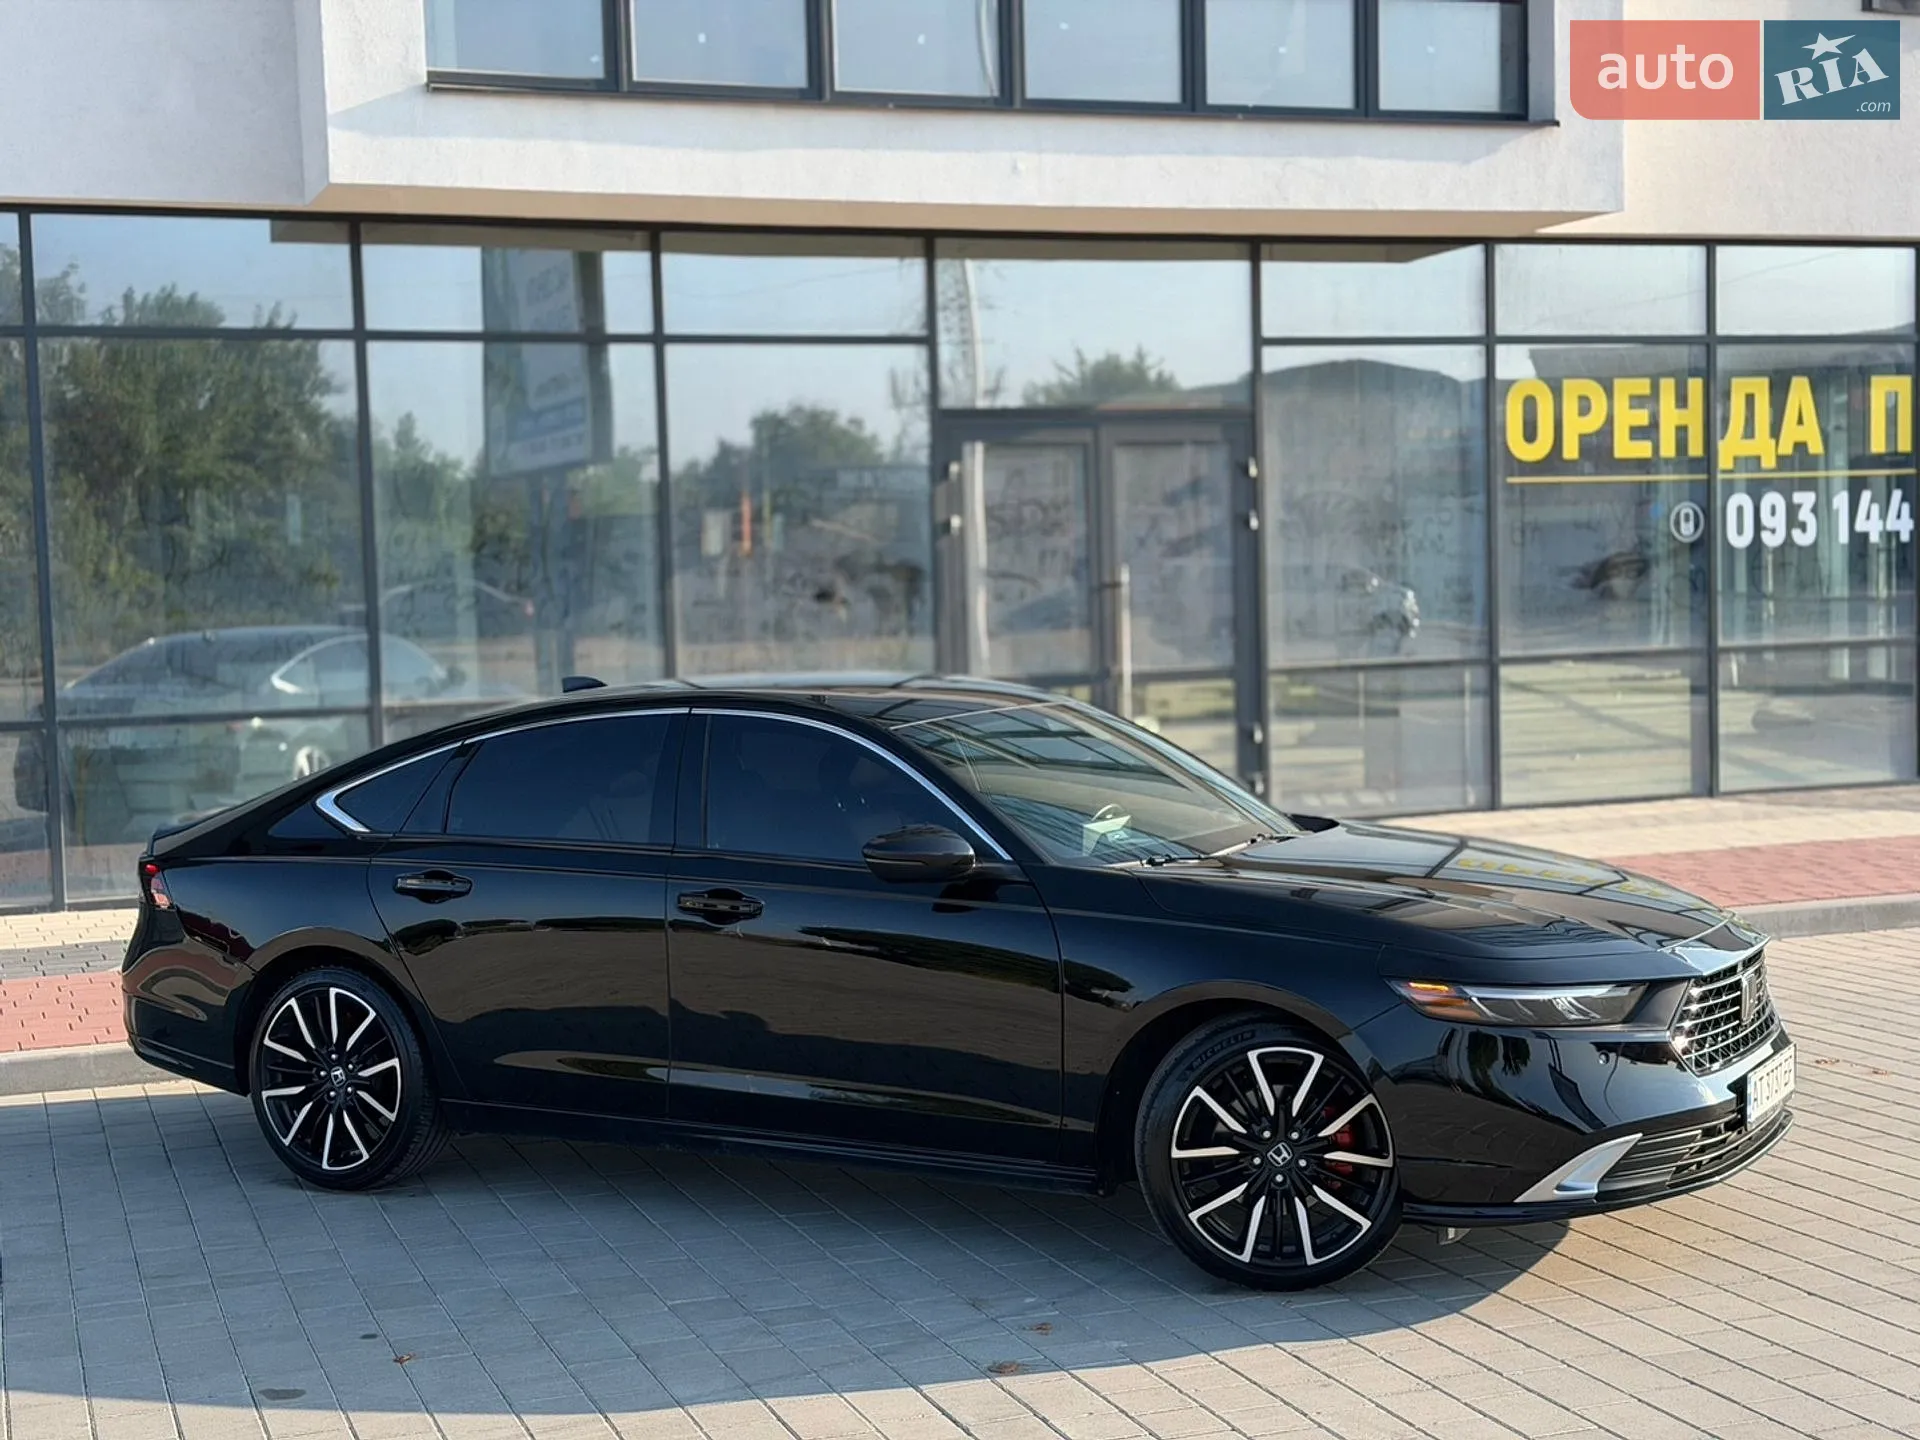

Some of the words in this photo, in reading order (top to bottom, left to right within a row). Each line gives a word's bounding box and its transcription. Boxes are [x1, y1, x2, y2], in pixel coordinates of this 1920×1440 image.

[1506, 375, 1825, 470] ОРЕНДА
[1870, 375, 1912, 453] П
[1726, 491, 1817, 549] 093
[1832, 488, 1914, 545] 144
[1193, 1032, 1253, 1068] MICHELIN
